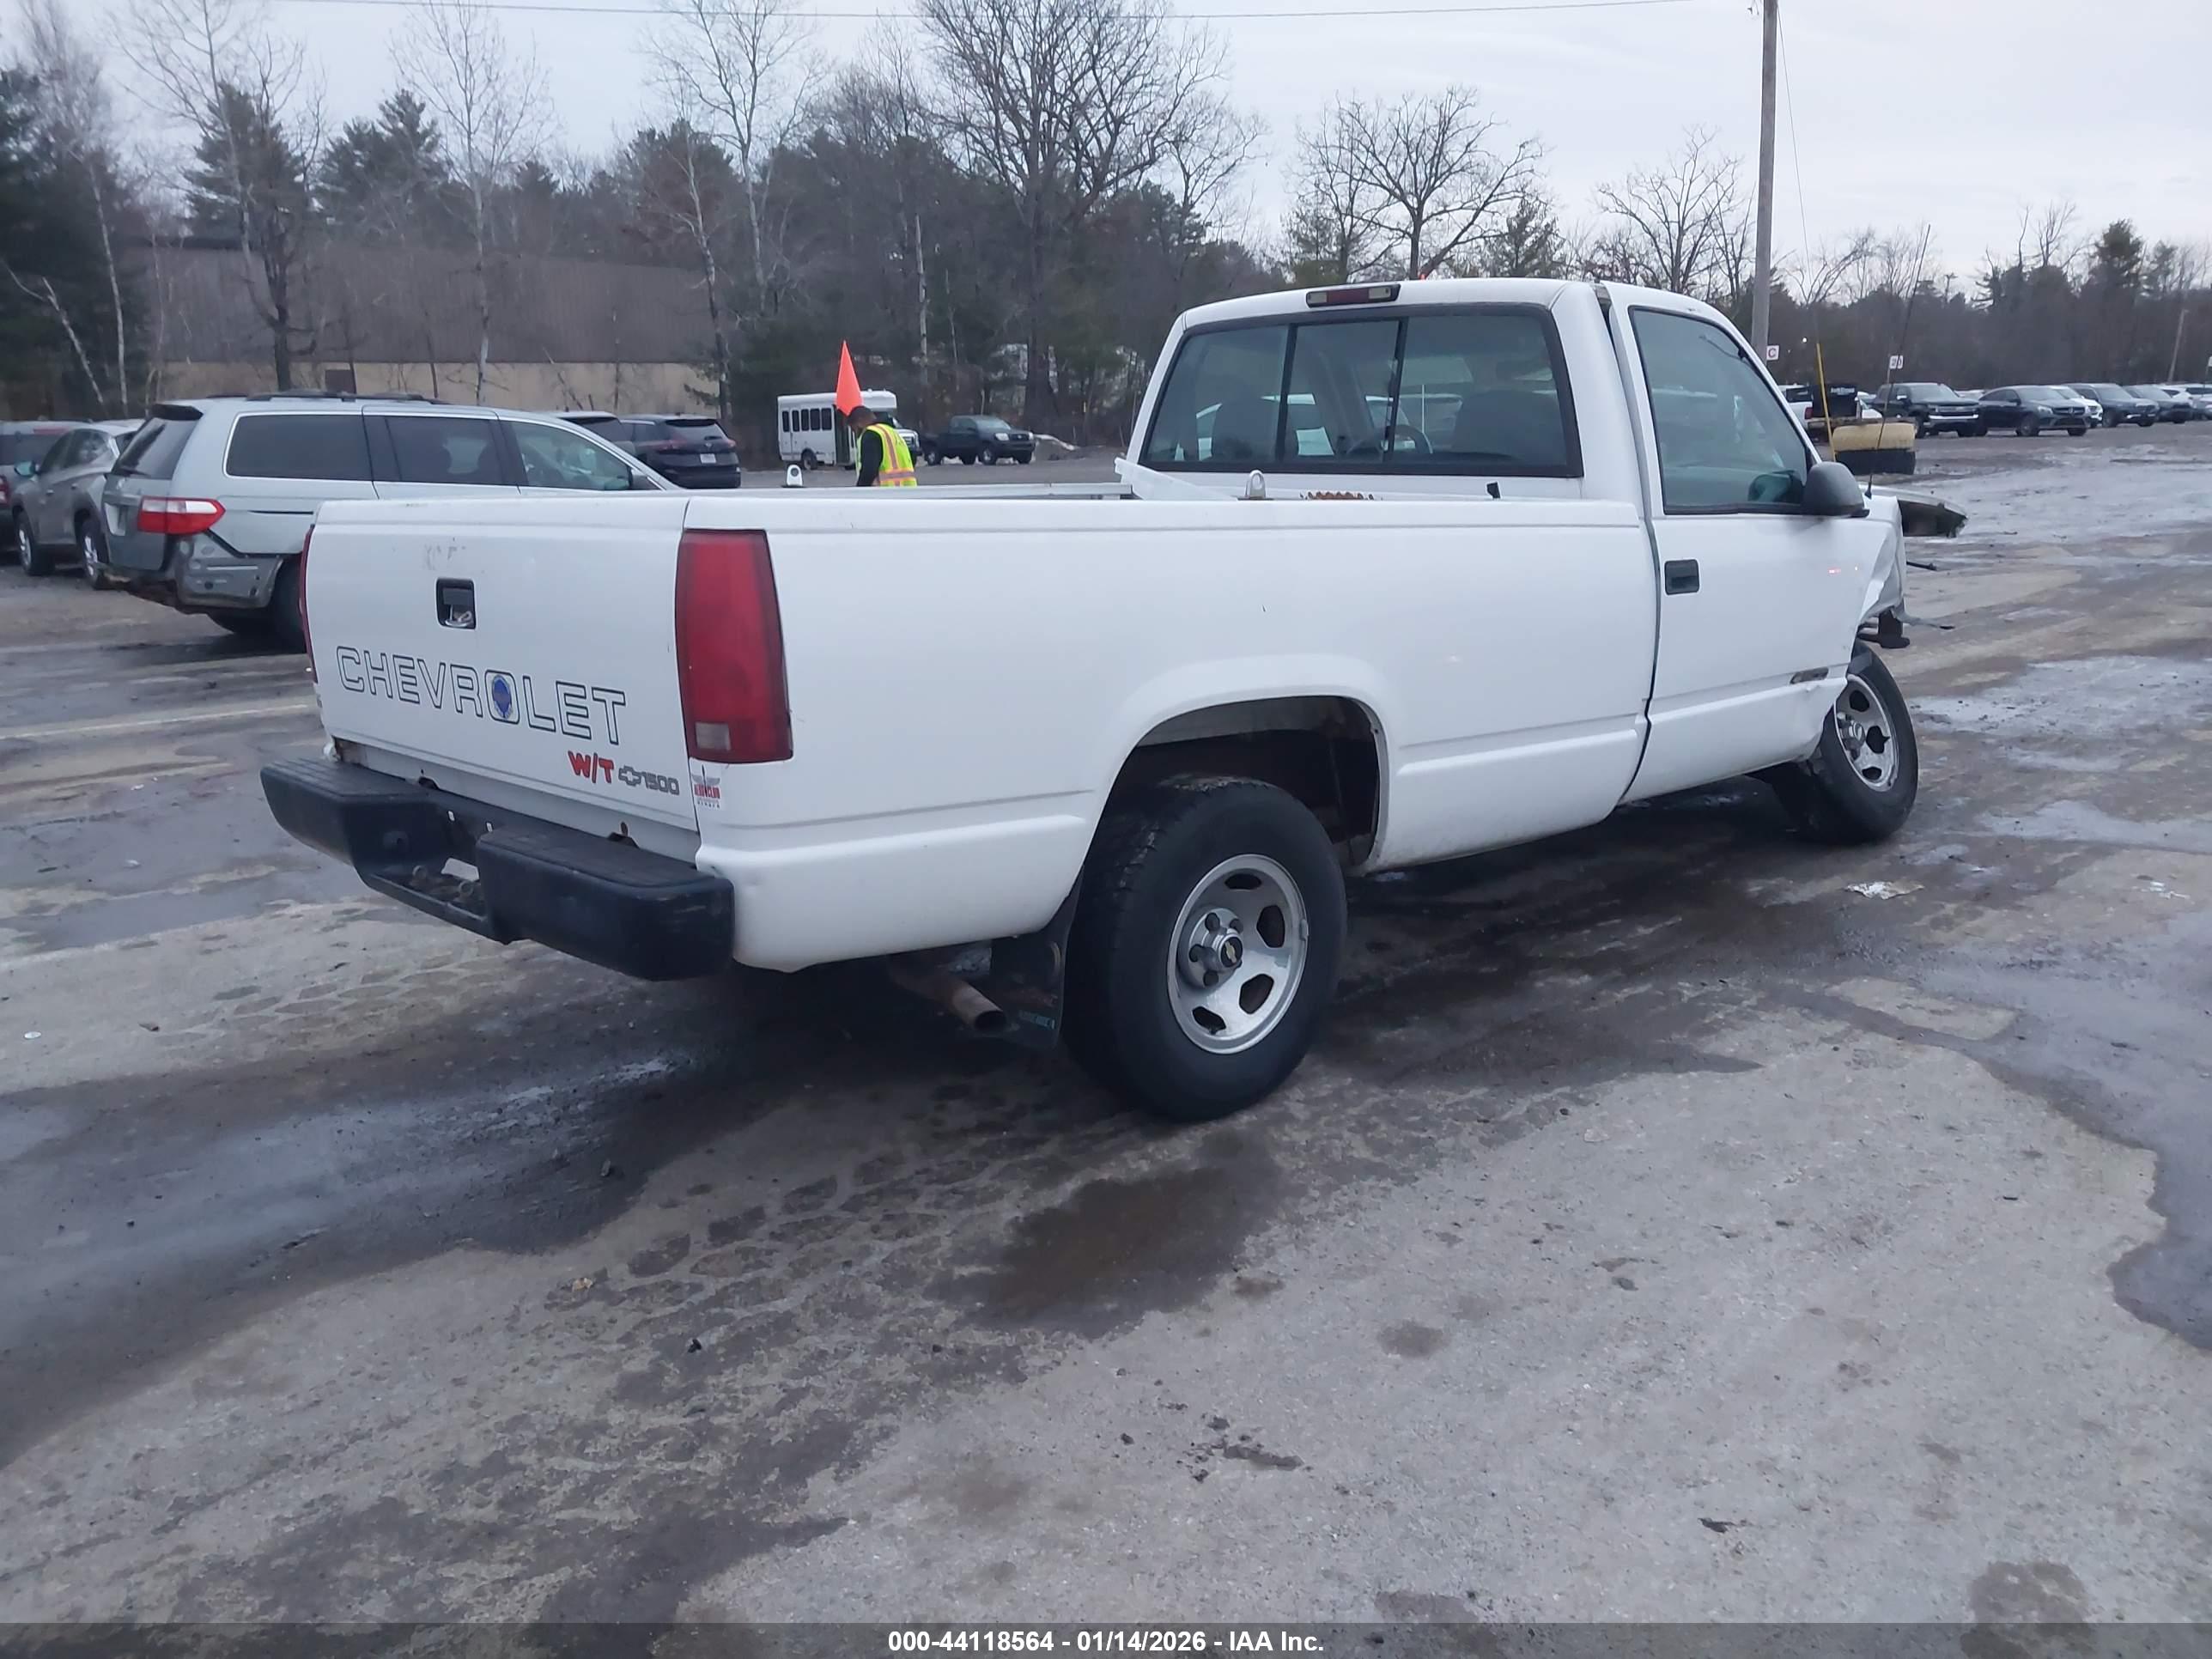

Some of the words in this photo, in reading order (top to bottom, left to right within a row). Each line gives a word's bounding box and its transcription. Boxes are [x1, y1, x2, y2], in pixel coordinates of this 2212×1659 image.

[336, 645, 626, 745] CHEVROLET
[567, 750, 615, 784] W/T
[643, 771, 680, 795] 1500
